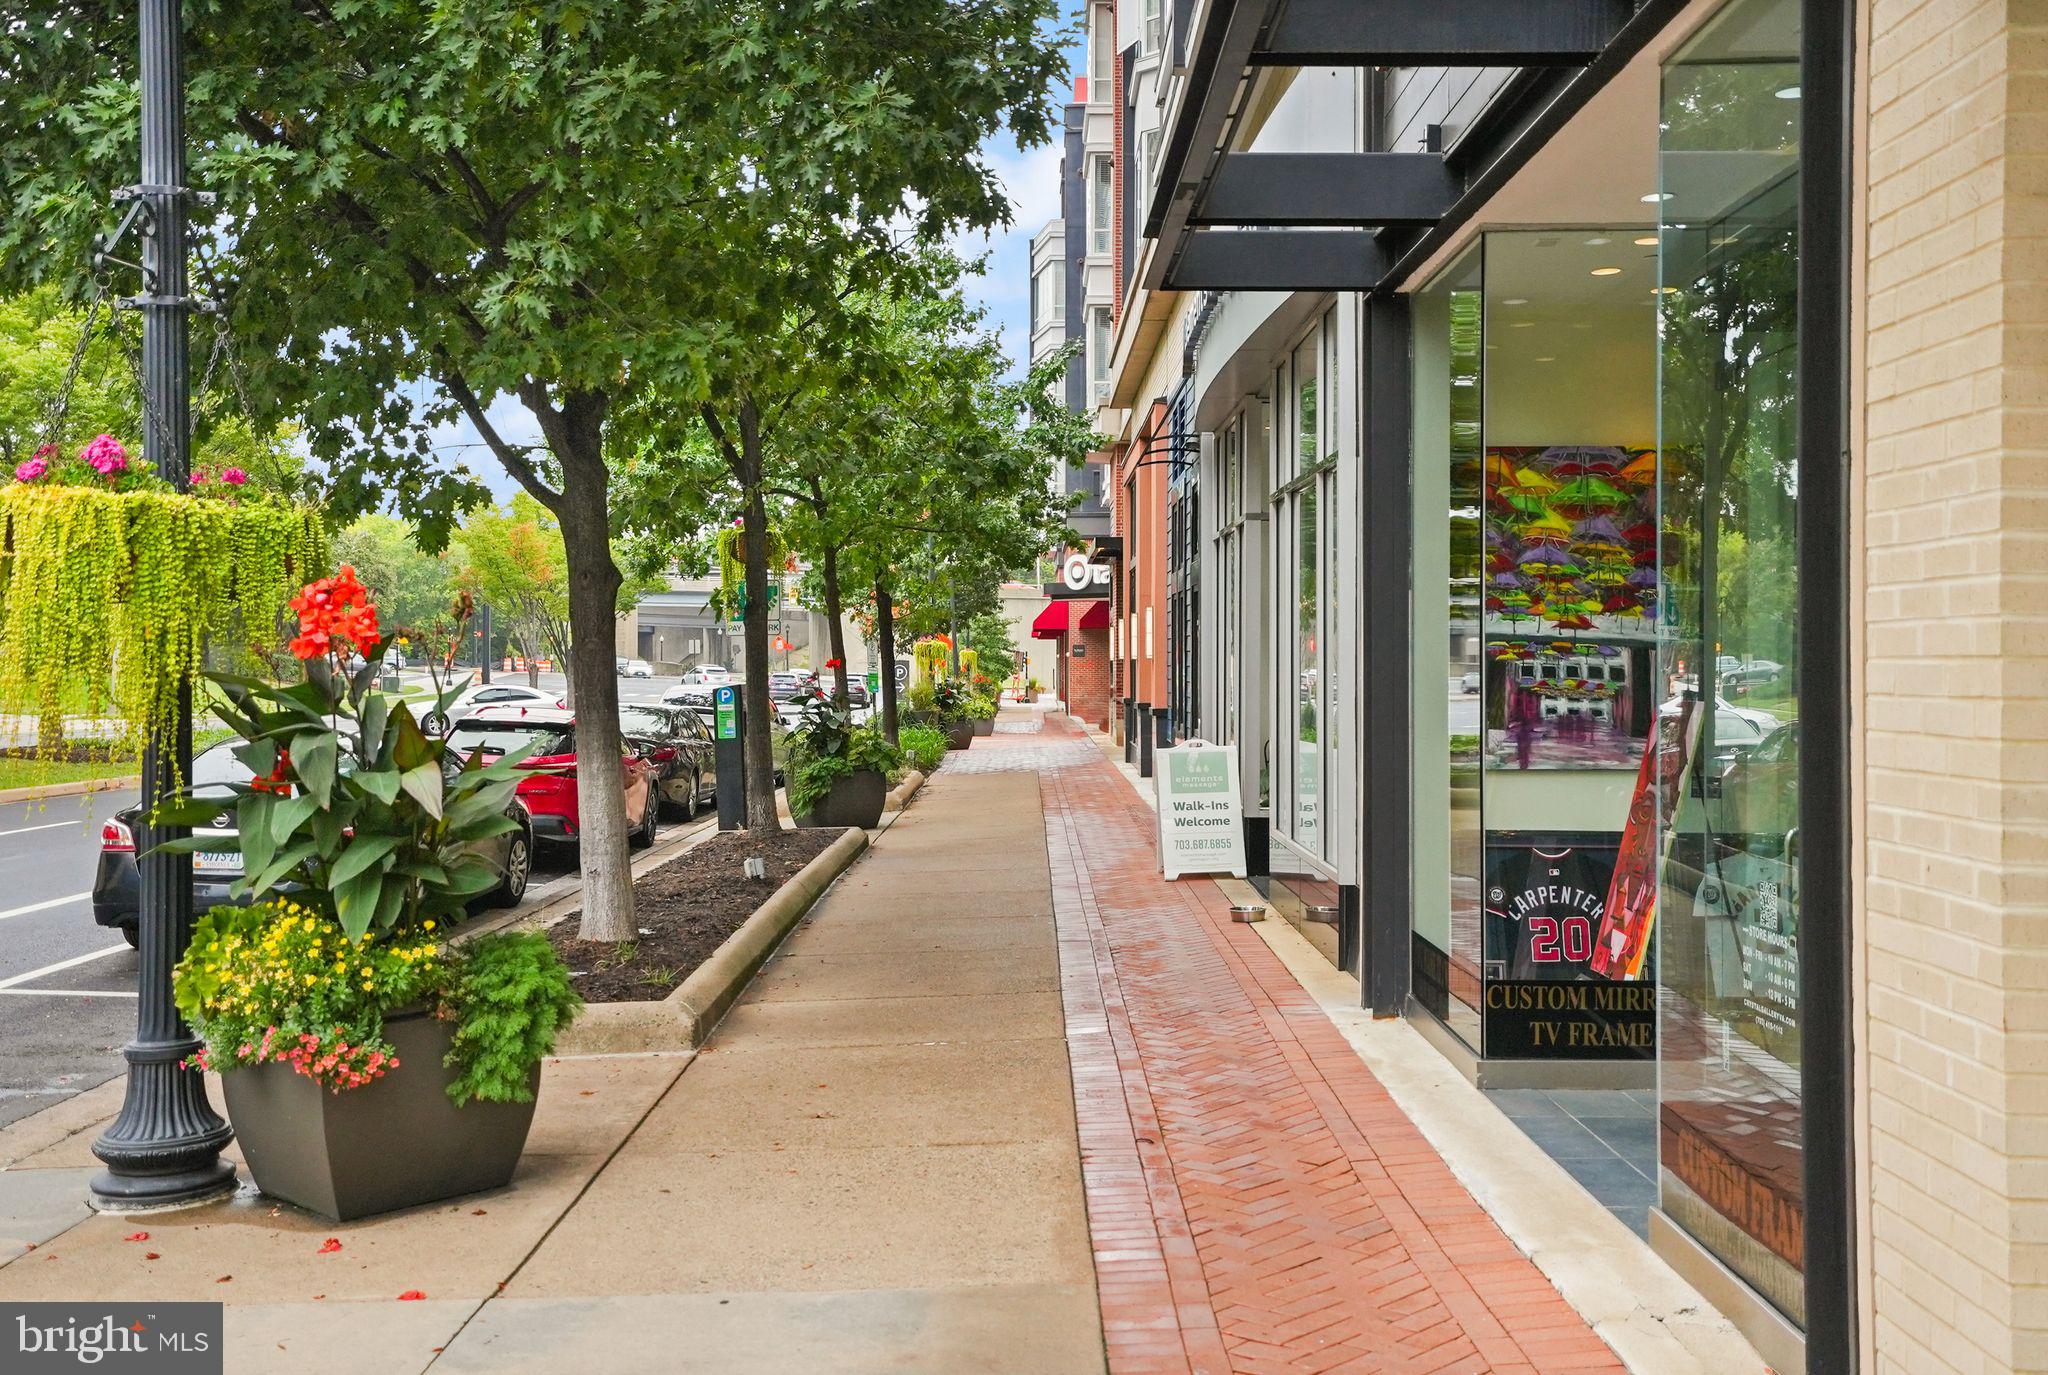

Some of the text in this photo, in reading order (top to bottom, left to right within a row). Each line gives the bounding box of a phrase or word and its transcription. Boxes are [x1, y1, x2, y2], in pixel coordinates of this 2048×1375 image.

[721, 689, 731, 702] P
[1173, 801, 1230, 811] Walk-Ins
[1174, 816, 1231, 827] Welcome
[1174, 838, 1232, 850] 703.687.6855
[1508, 885, 1604, 921] CARPENTER
[1528, 916, 1592, 963] 20
[1748, 924, 1788, 949] STORE HOURS
[1487, 985, 1656, 1010] CUSTOM MIRR
[1529, 1021, 1654, 1047] TV FRAME
